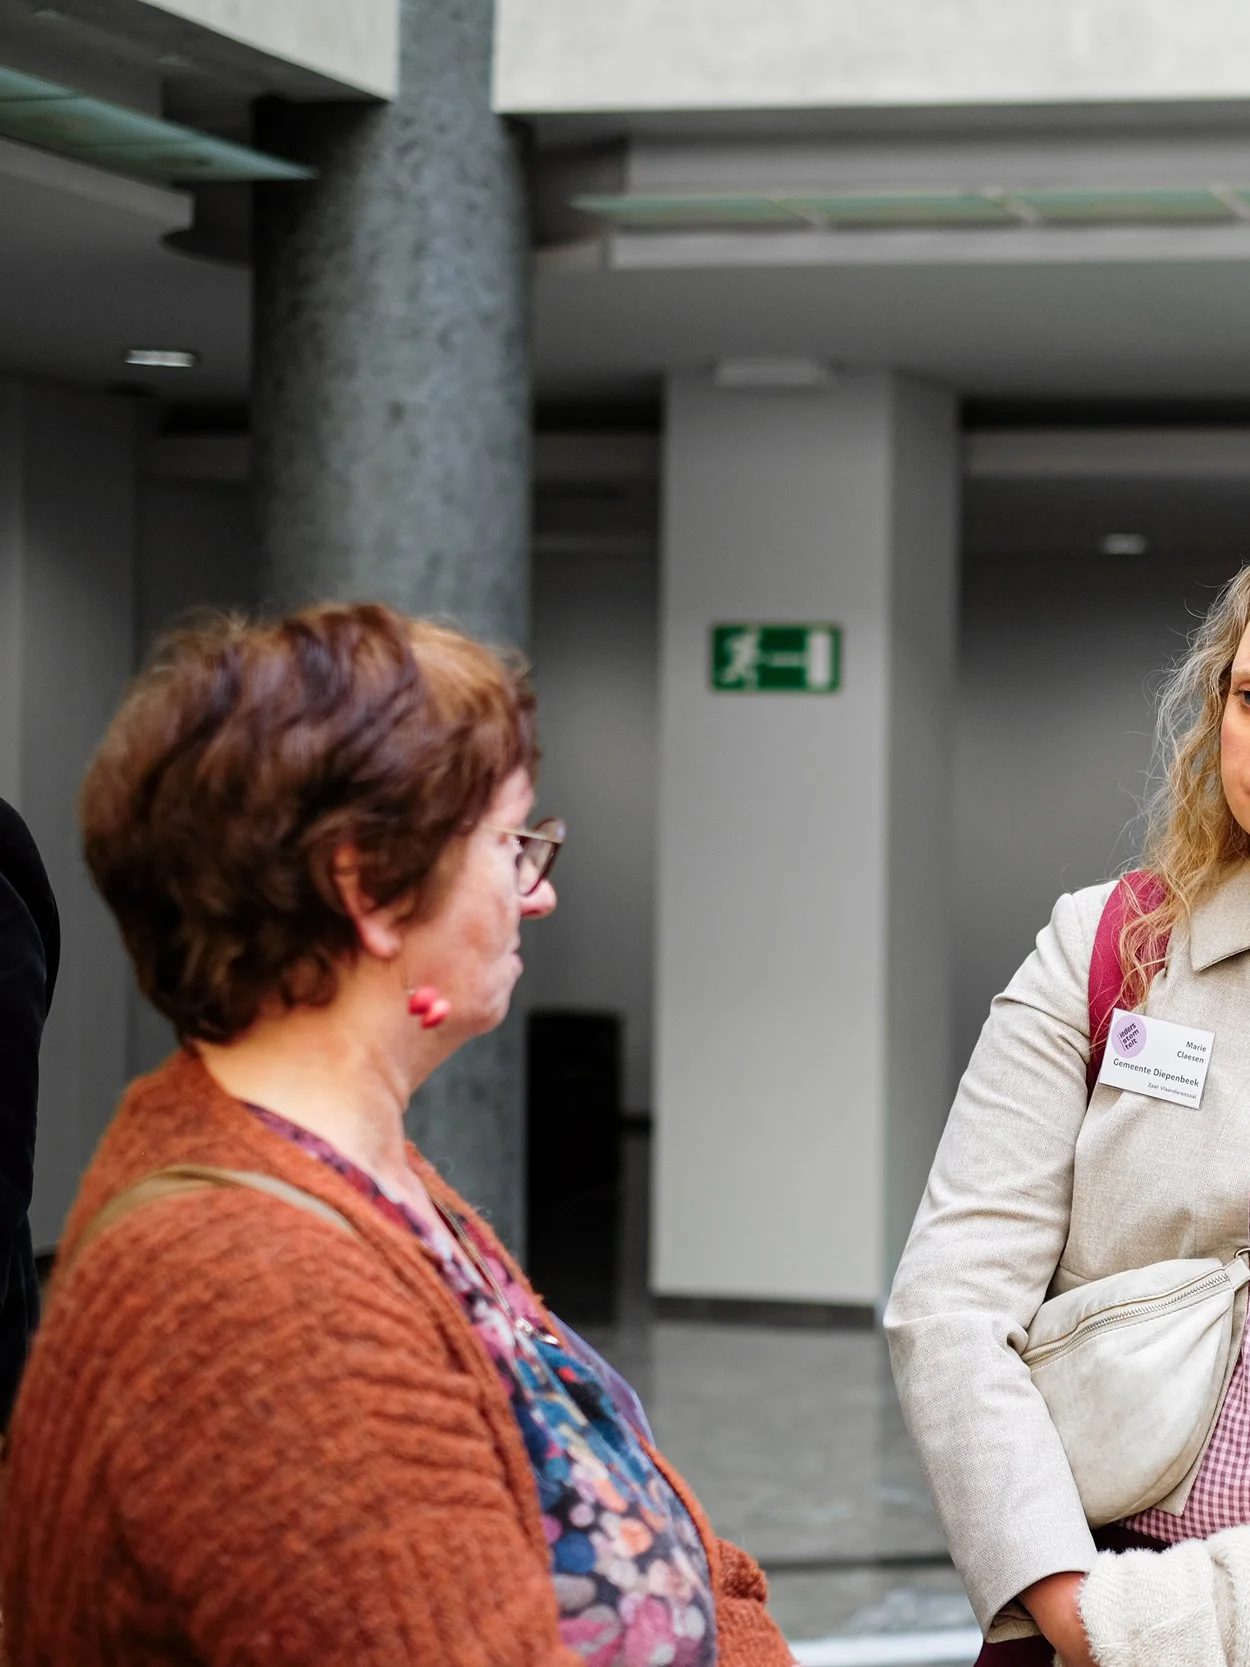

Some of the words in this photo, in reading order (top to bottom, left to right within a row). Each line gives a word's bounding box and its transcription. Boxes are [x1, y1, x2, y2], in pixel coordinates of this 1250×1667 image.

[1186, 1041, 1207, 1053] Marie
[1177, 1050, 1204, 1064] Claesen
[1113, 1058, 1152, 1075] Gemeente
[1153, 1068, 1200, 1087] Diepenbeek
